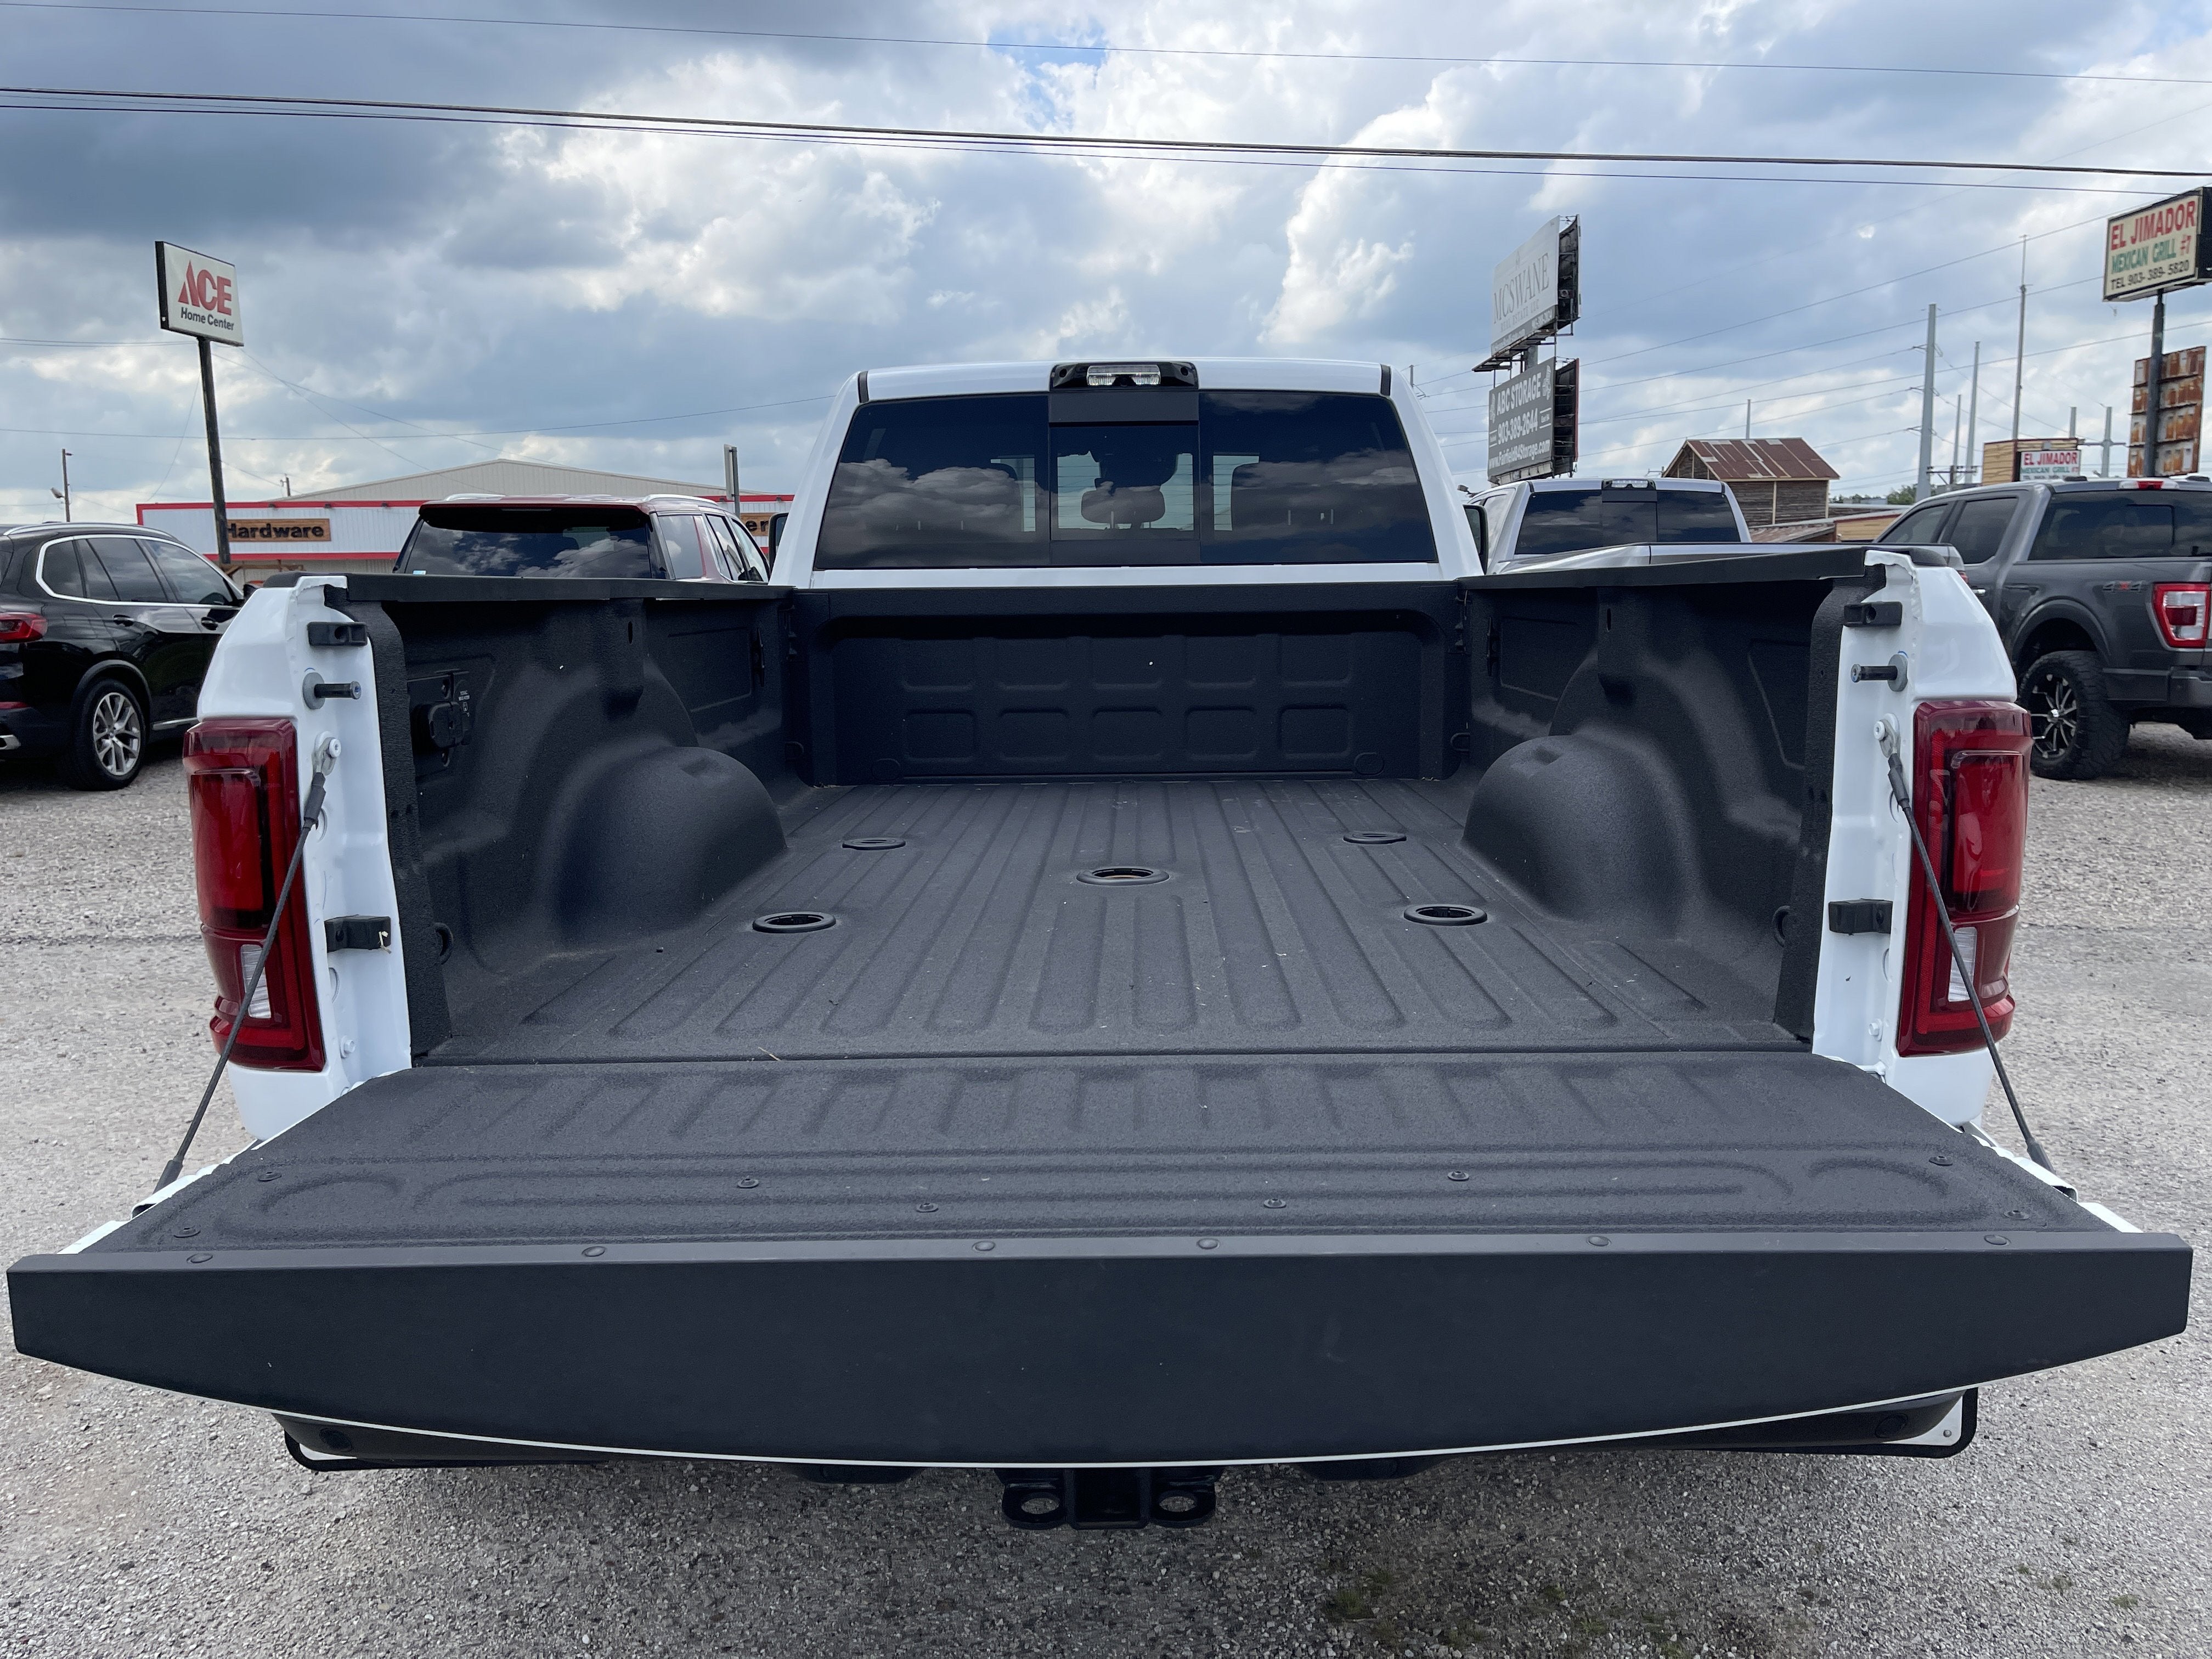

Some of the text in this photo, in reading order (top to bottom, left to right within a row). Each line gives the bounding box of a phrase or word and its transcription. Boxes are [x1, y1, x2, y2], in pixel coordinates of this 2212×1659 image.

[2111, 201, 2196, 251] EL JIMADOR
[2111, 246, 2149, 274] MEXICAN
[2153, 239, 2176, 263] GRILL
[178, 259, 232, 316] ACE
[1494, 252, 1550, 324] MCSWANE
[2111, 277, 2125, 290] TEL
[181, 307, 234, 330] Home Center
[1497, 373, 1541, 416] ABC STORAGE
[1498, 408, 1538, 445] 903-389-2644
[2024, 452, 2077, 465] EL JIMADOR
